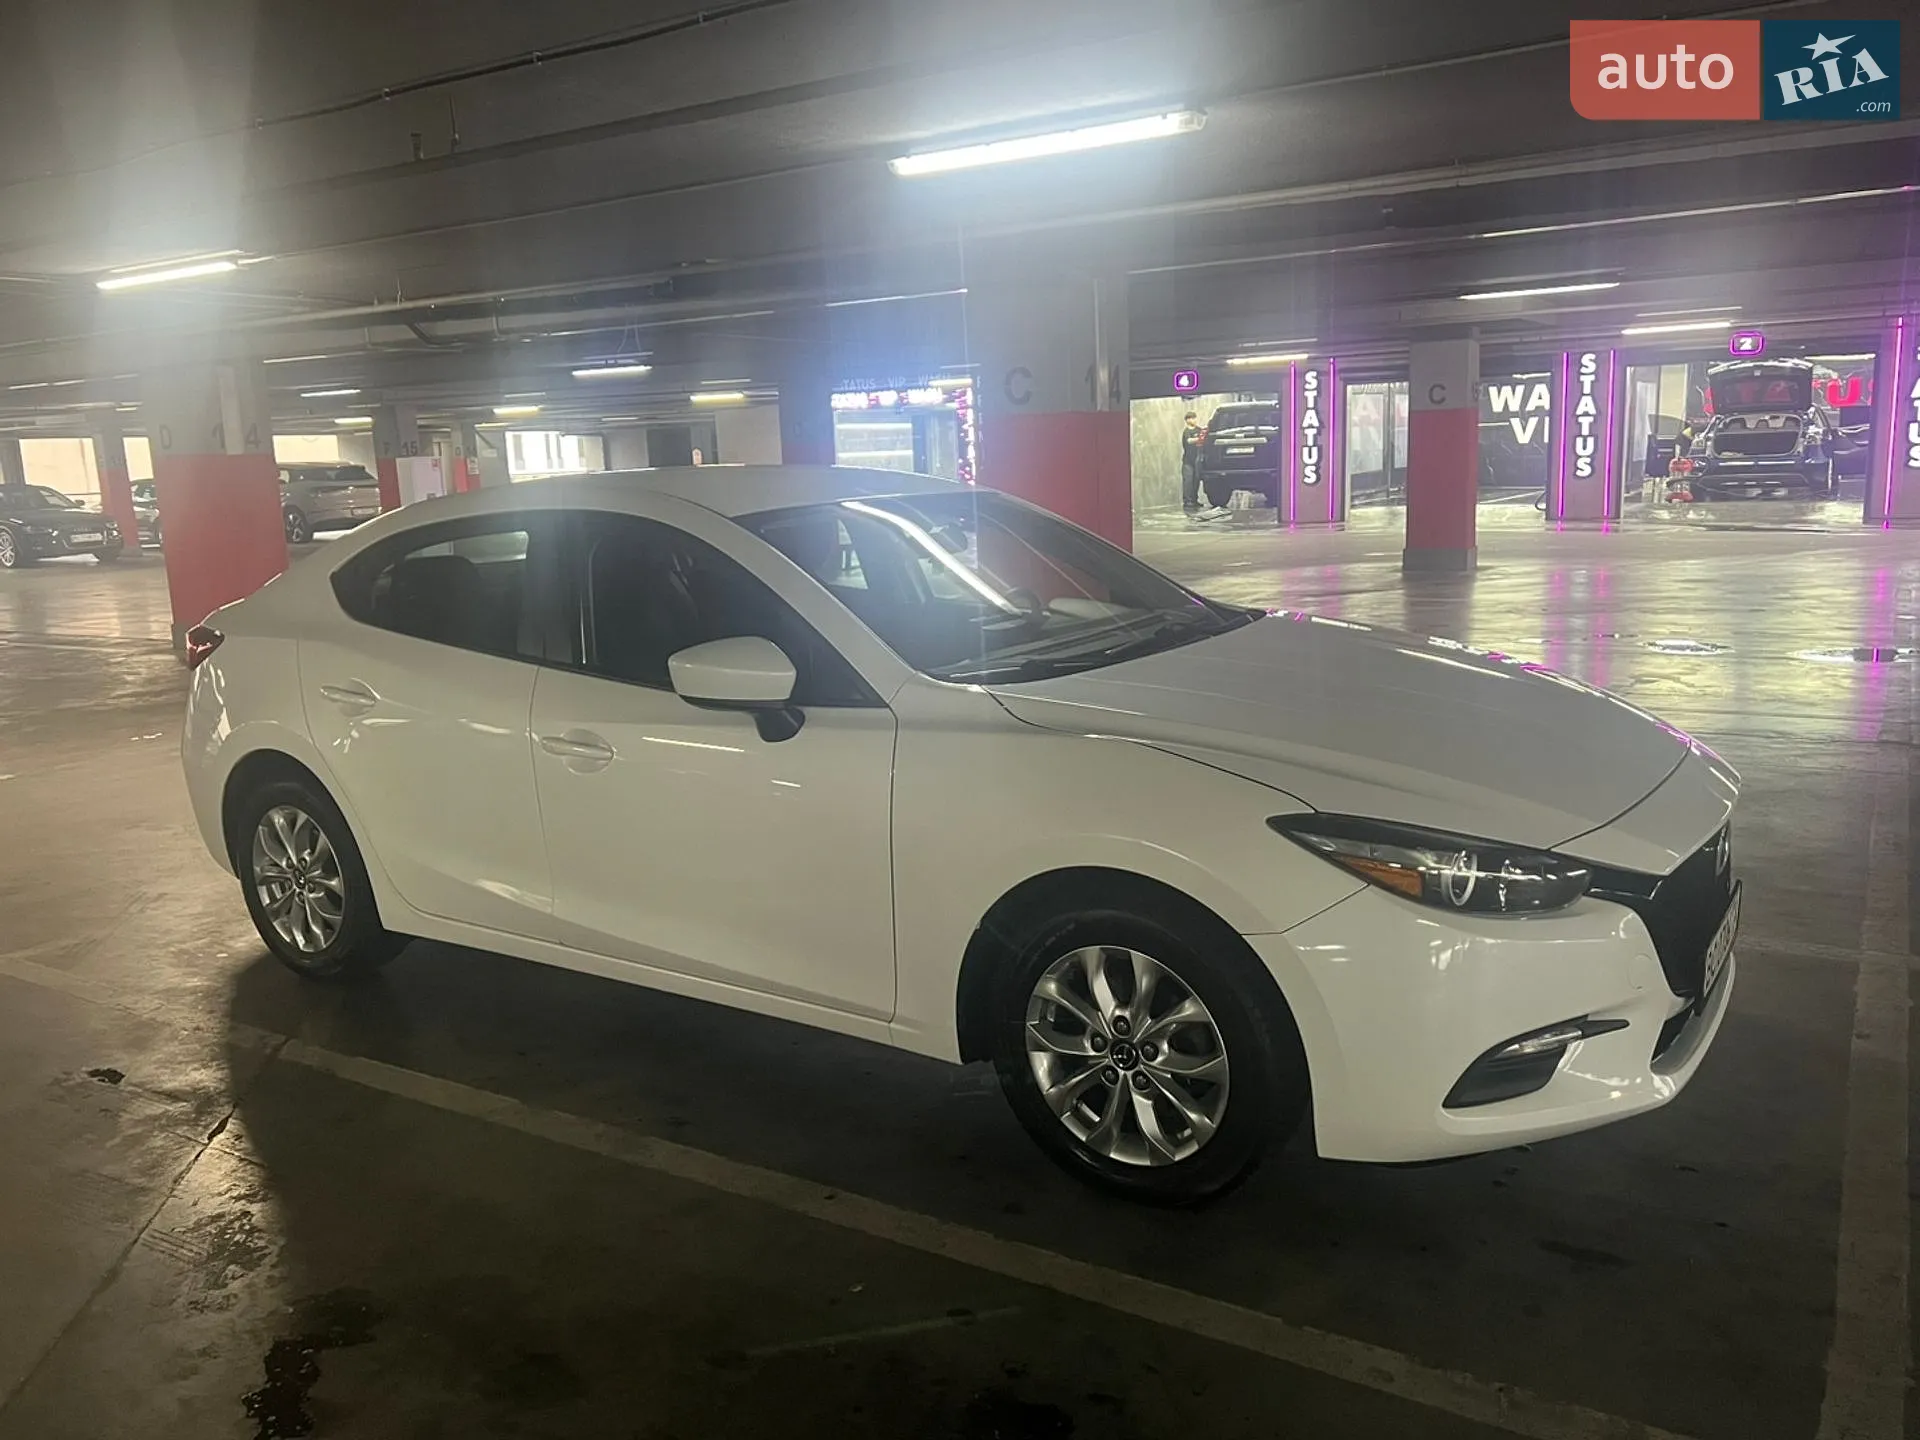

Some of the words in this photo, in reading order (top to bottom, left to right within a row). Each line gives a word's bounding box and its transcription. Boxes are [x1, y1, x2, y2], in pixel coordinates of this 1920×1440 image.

[1739, 336, 1752, 351] 2
[1003, 366, 1033, 406] C
[1428, 384, 1447, 405] C
[1302, 370, 1320, 484] STATUS
[1575, 352, 1597, 477] STATUS
